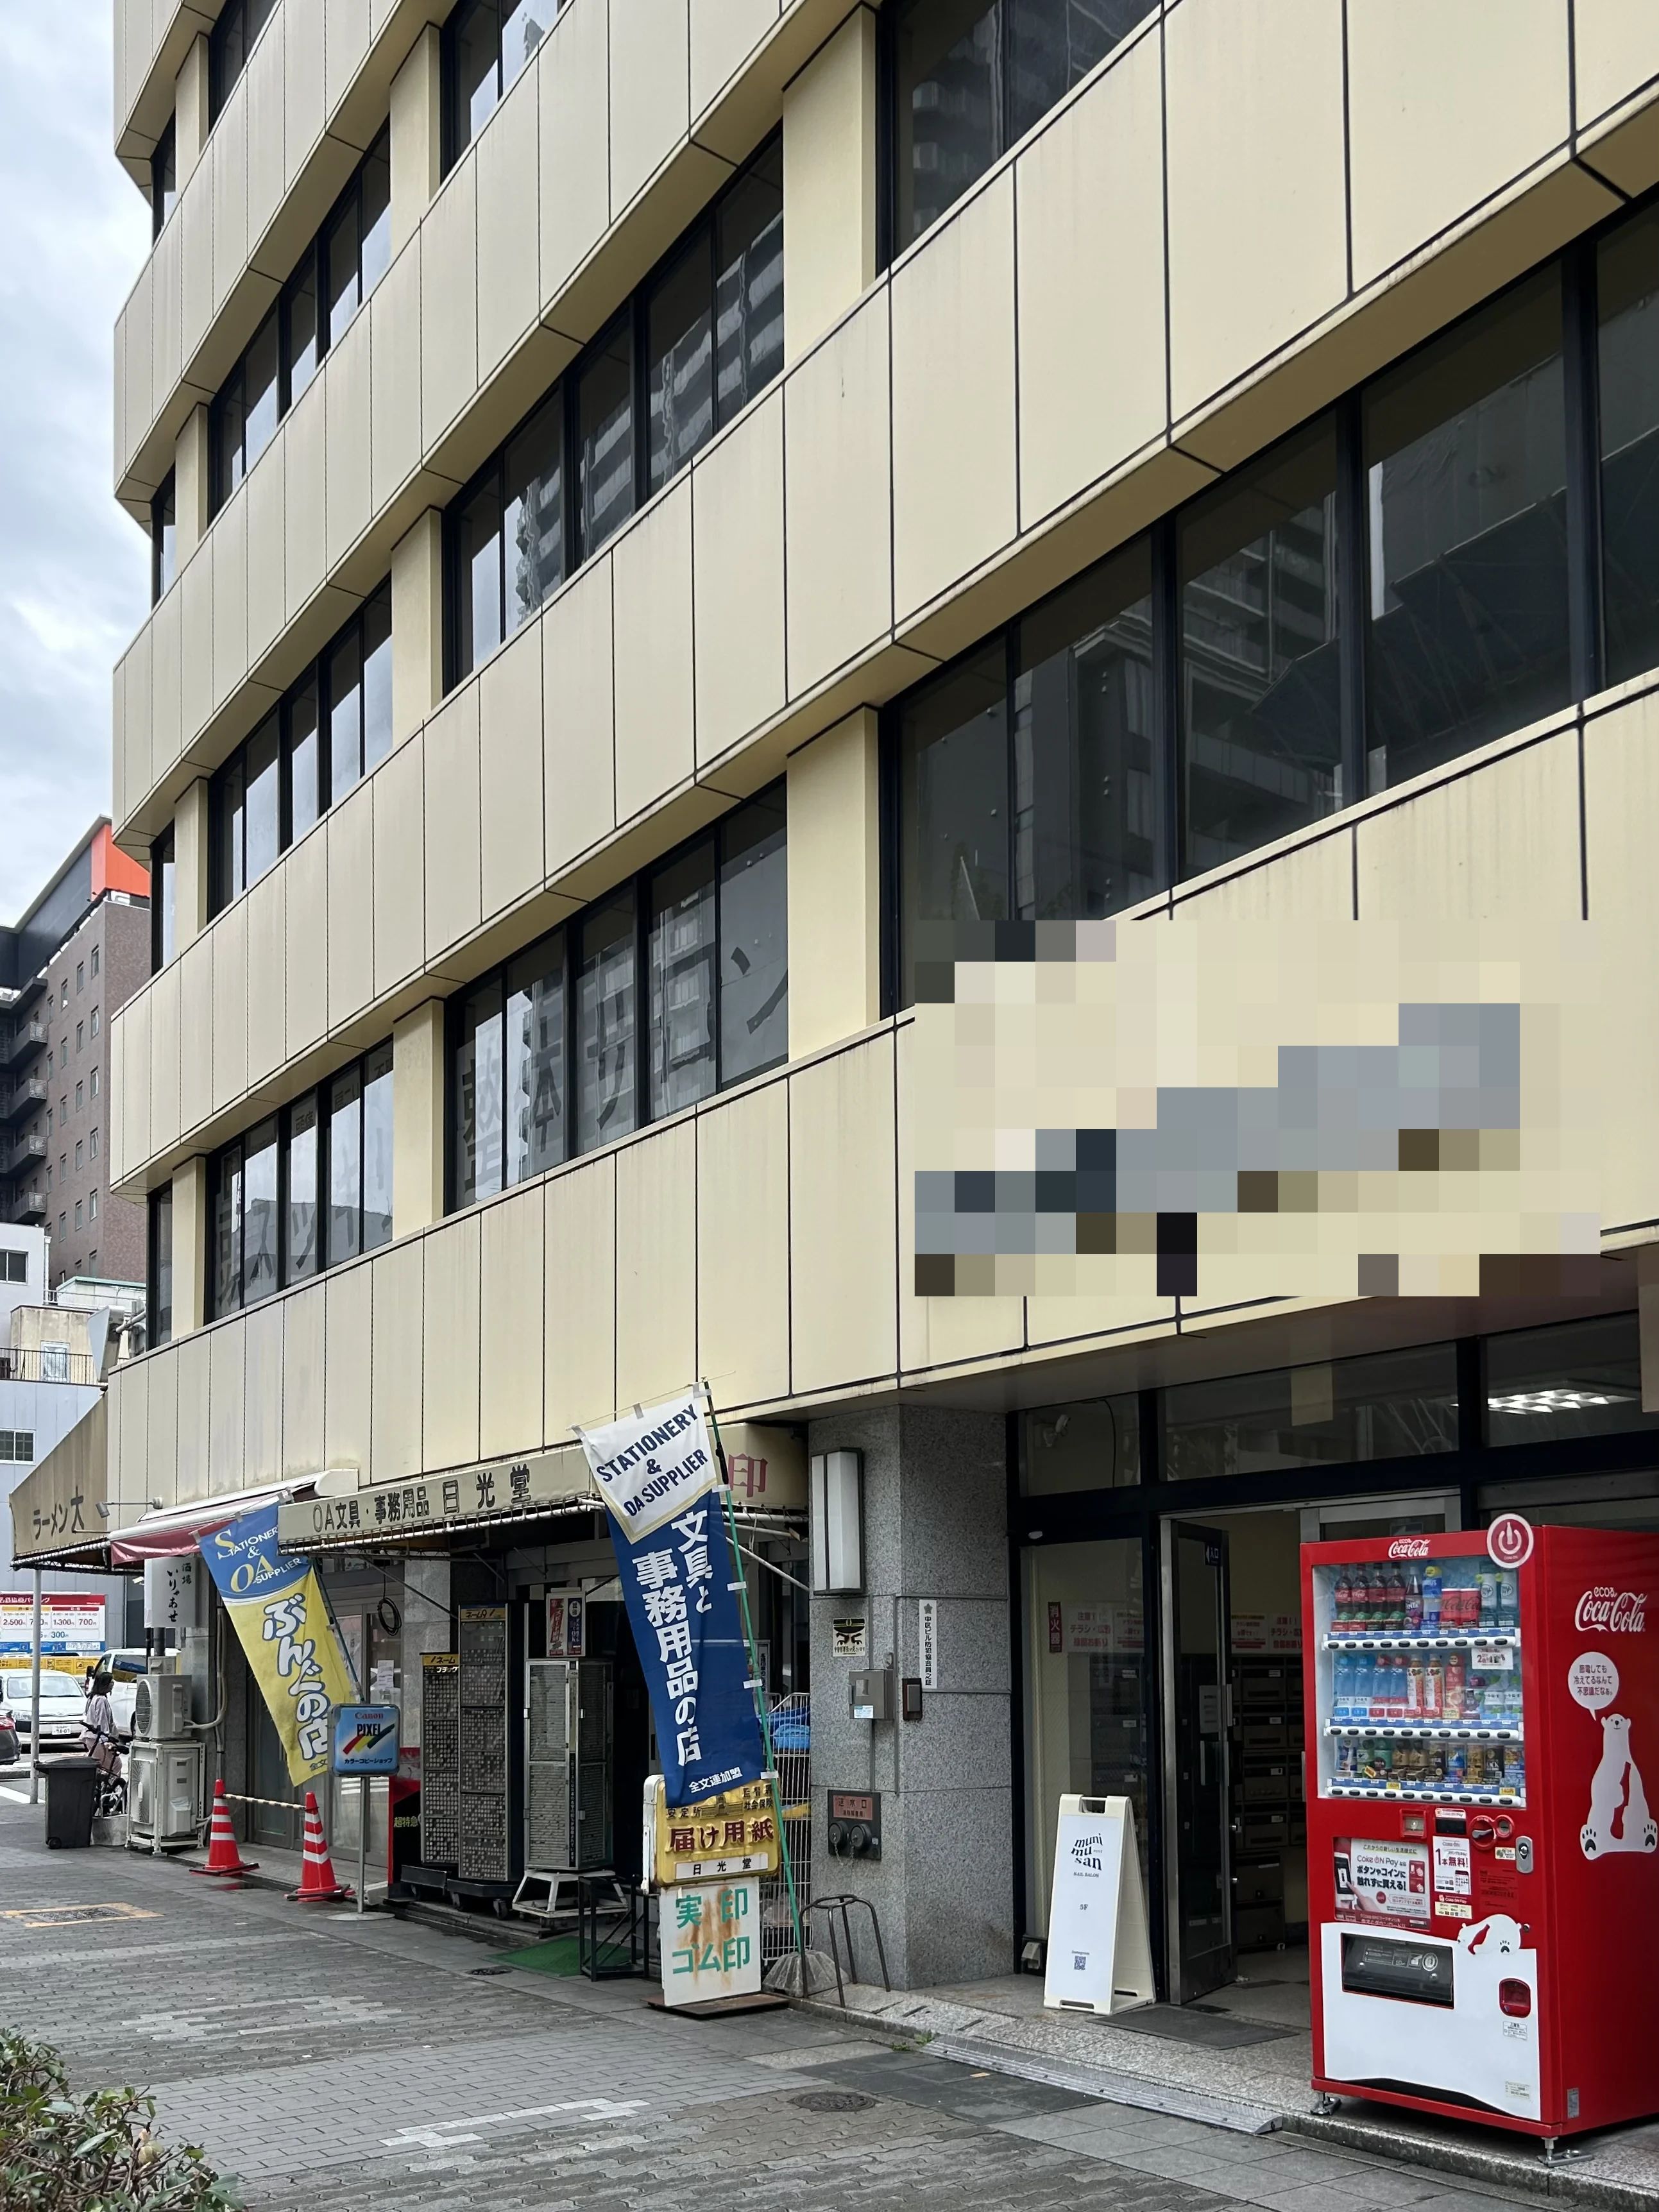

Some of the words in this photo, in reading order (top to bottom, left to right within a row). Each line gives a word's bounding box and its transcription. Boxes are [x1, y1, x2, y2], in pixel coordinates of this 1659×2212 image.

[597, 1404, 698, 1483] STATIONERY
[641, 1449, 708, 1503] SUPPLIER
[647, 1458, 661, 1474] &
[729, 1453, 769, 1497] 印
[313, 1486, 430, 1533] OA文具・事務用品
[443, 1463, 531, 1513] 日光堂
[215, 1526, 278, 1560] STATIONER
[248, 1546, 260, 1559] &
[1389, 1539, 1431, 1559] Coca-Cola
[255, 1558, 302, 1585] SUPPLIER
[672, 1509, 713, 1613] 文具と
[182, 1563, 192, 1585] 酒場
[167, 1569, 180, 1622] いりゃあせ
[1575, 1591, 1647, 1633] Coca-Cola
[632, 1547, 702, 1767] 事務用品の店
[1574, 1676, 1612, 1685] 冷えてるなんて
[355, 1712, 384, 1720] Canon
[357, 1724, 381, 1736] PIXEL
[688, 1766, 743, 1793] 全文連加盟
[667, 1807, 701, 1818] 安定所
[744, 1798, 772, 1810] 社会保険
[670, 1817, 774, 1852] 届け用紙
[1075, 1833, 1103, 1848] muni
[1071, 1846, 1092, 1856] mu
[693, 1857, 752, 1876] 日光堂
[1074, 1857, 1102, 1871] san
[1357, 1865, 1406, 1878] ボタンやコインに
[1386, 1858, 1399, 1867] Pay
[1357, 1876, 1406, 1891] 触れずに買える!
[676, 1888, 748, 1928] 実印
[672, 1936, 750, 1975] ゴム印
